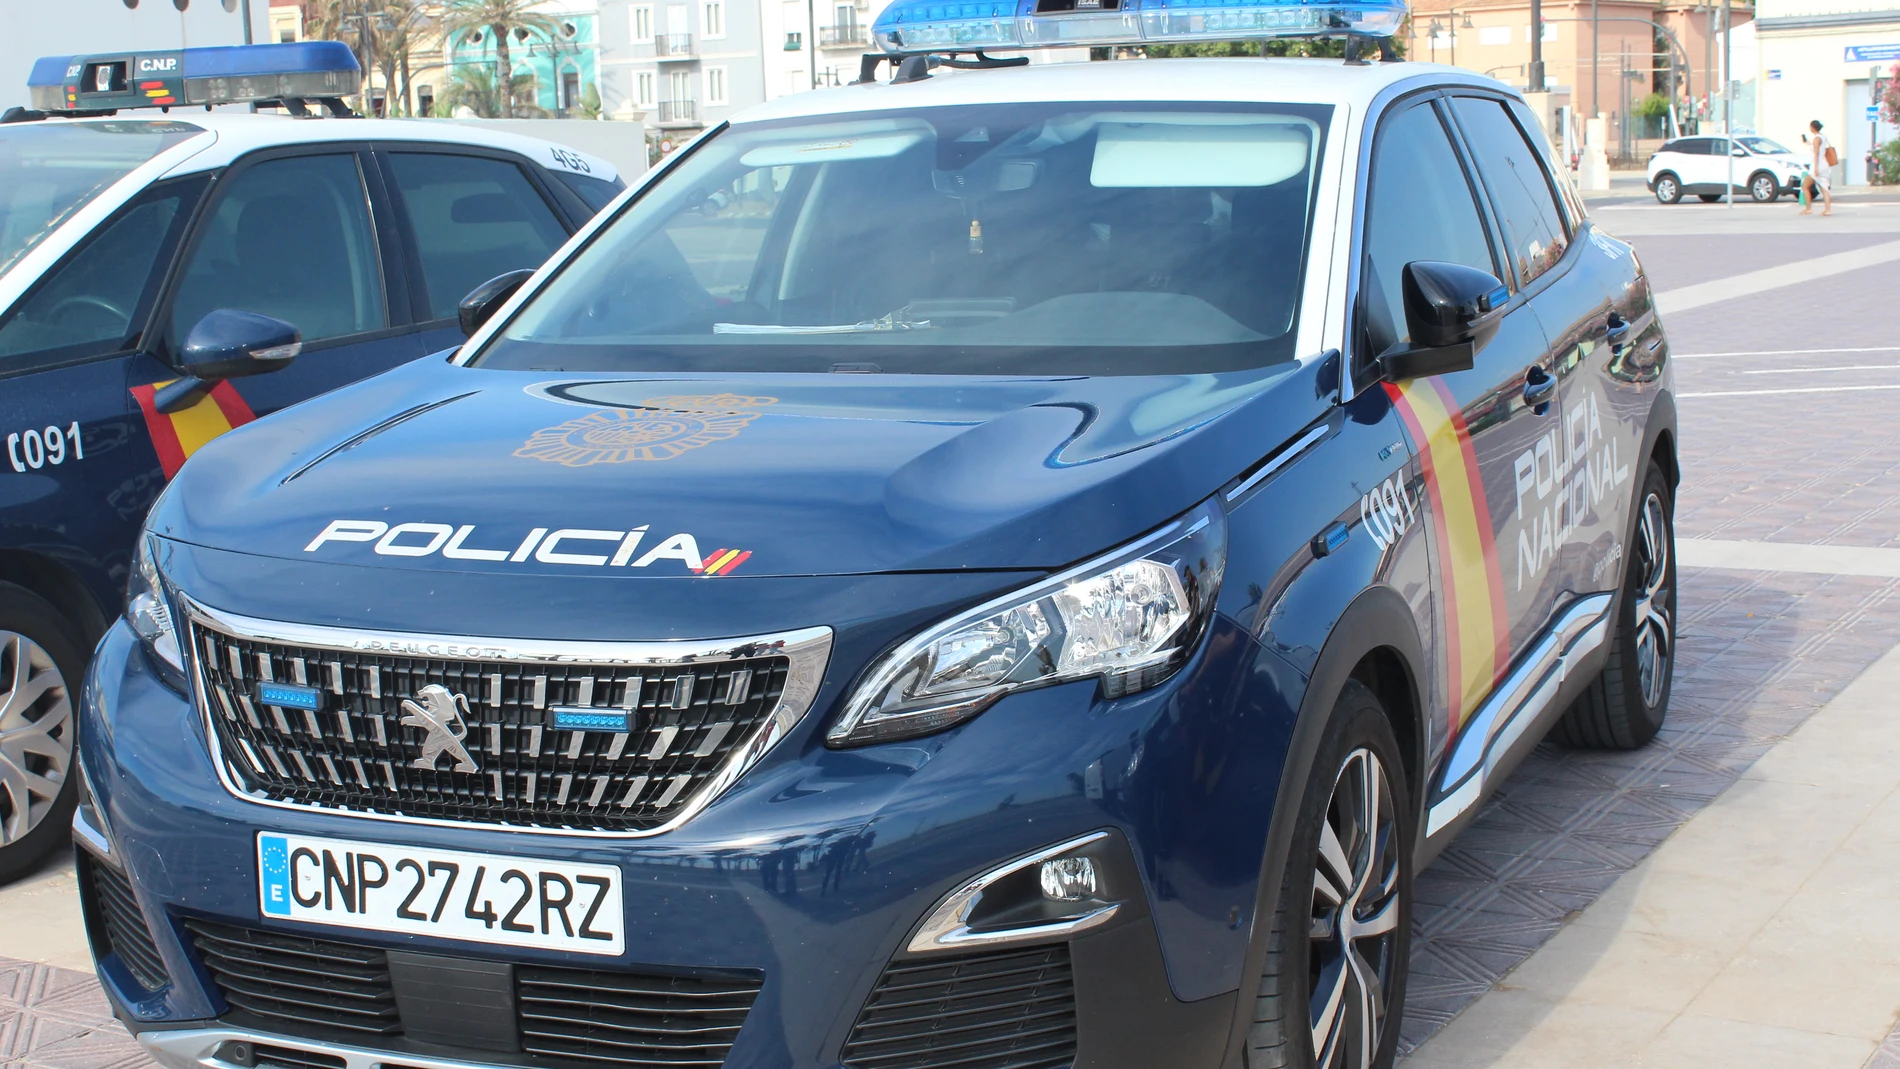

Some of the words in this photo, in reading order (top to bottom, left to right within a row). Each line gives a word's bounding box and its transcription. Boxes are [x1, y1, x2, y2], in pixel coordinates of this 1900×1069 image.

[140, 58, 177, 71] C.N.P.
[23, 421, 83, 469] 091
[1514, 384, 1602, 520] POLICÍA
[1369, 469, 1415, 544] 091
[1517, 436, 1628, 592] NACIONAL
[304, 520, 704, 569] POLICÍA
[371, 641, 507, 658] PEUGEOT
